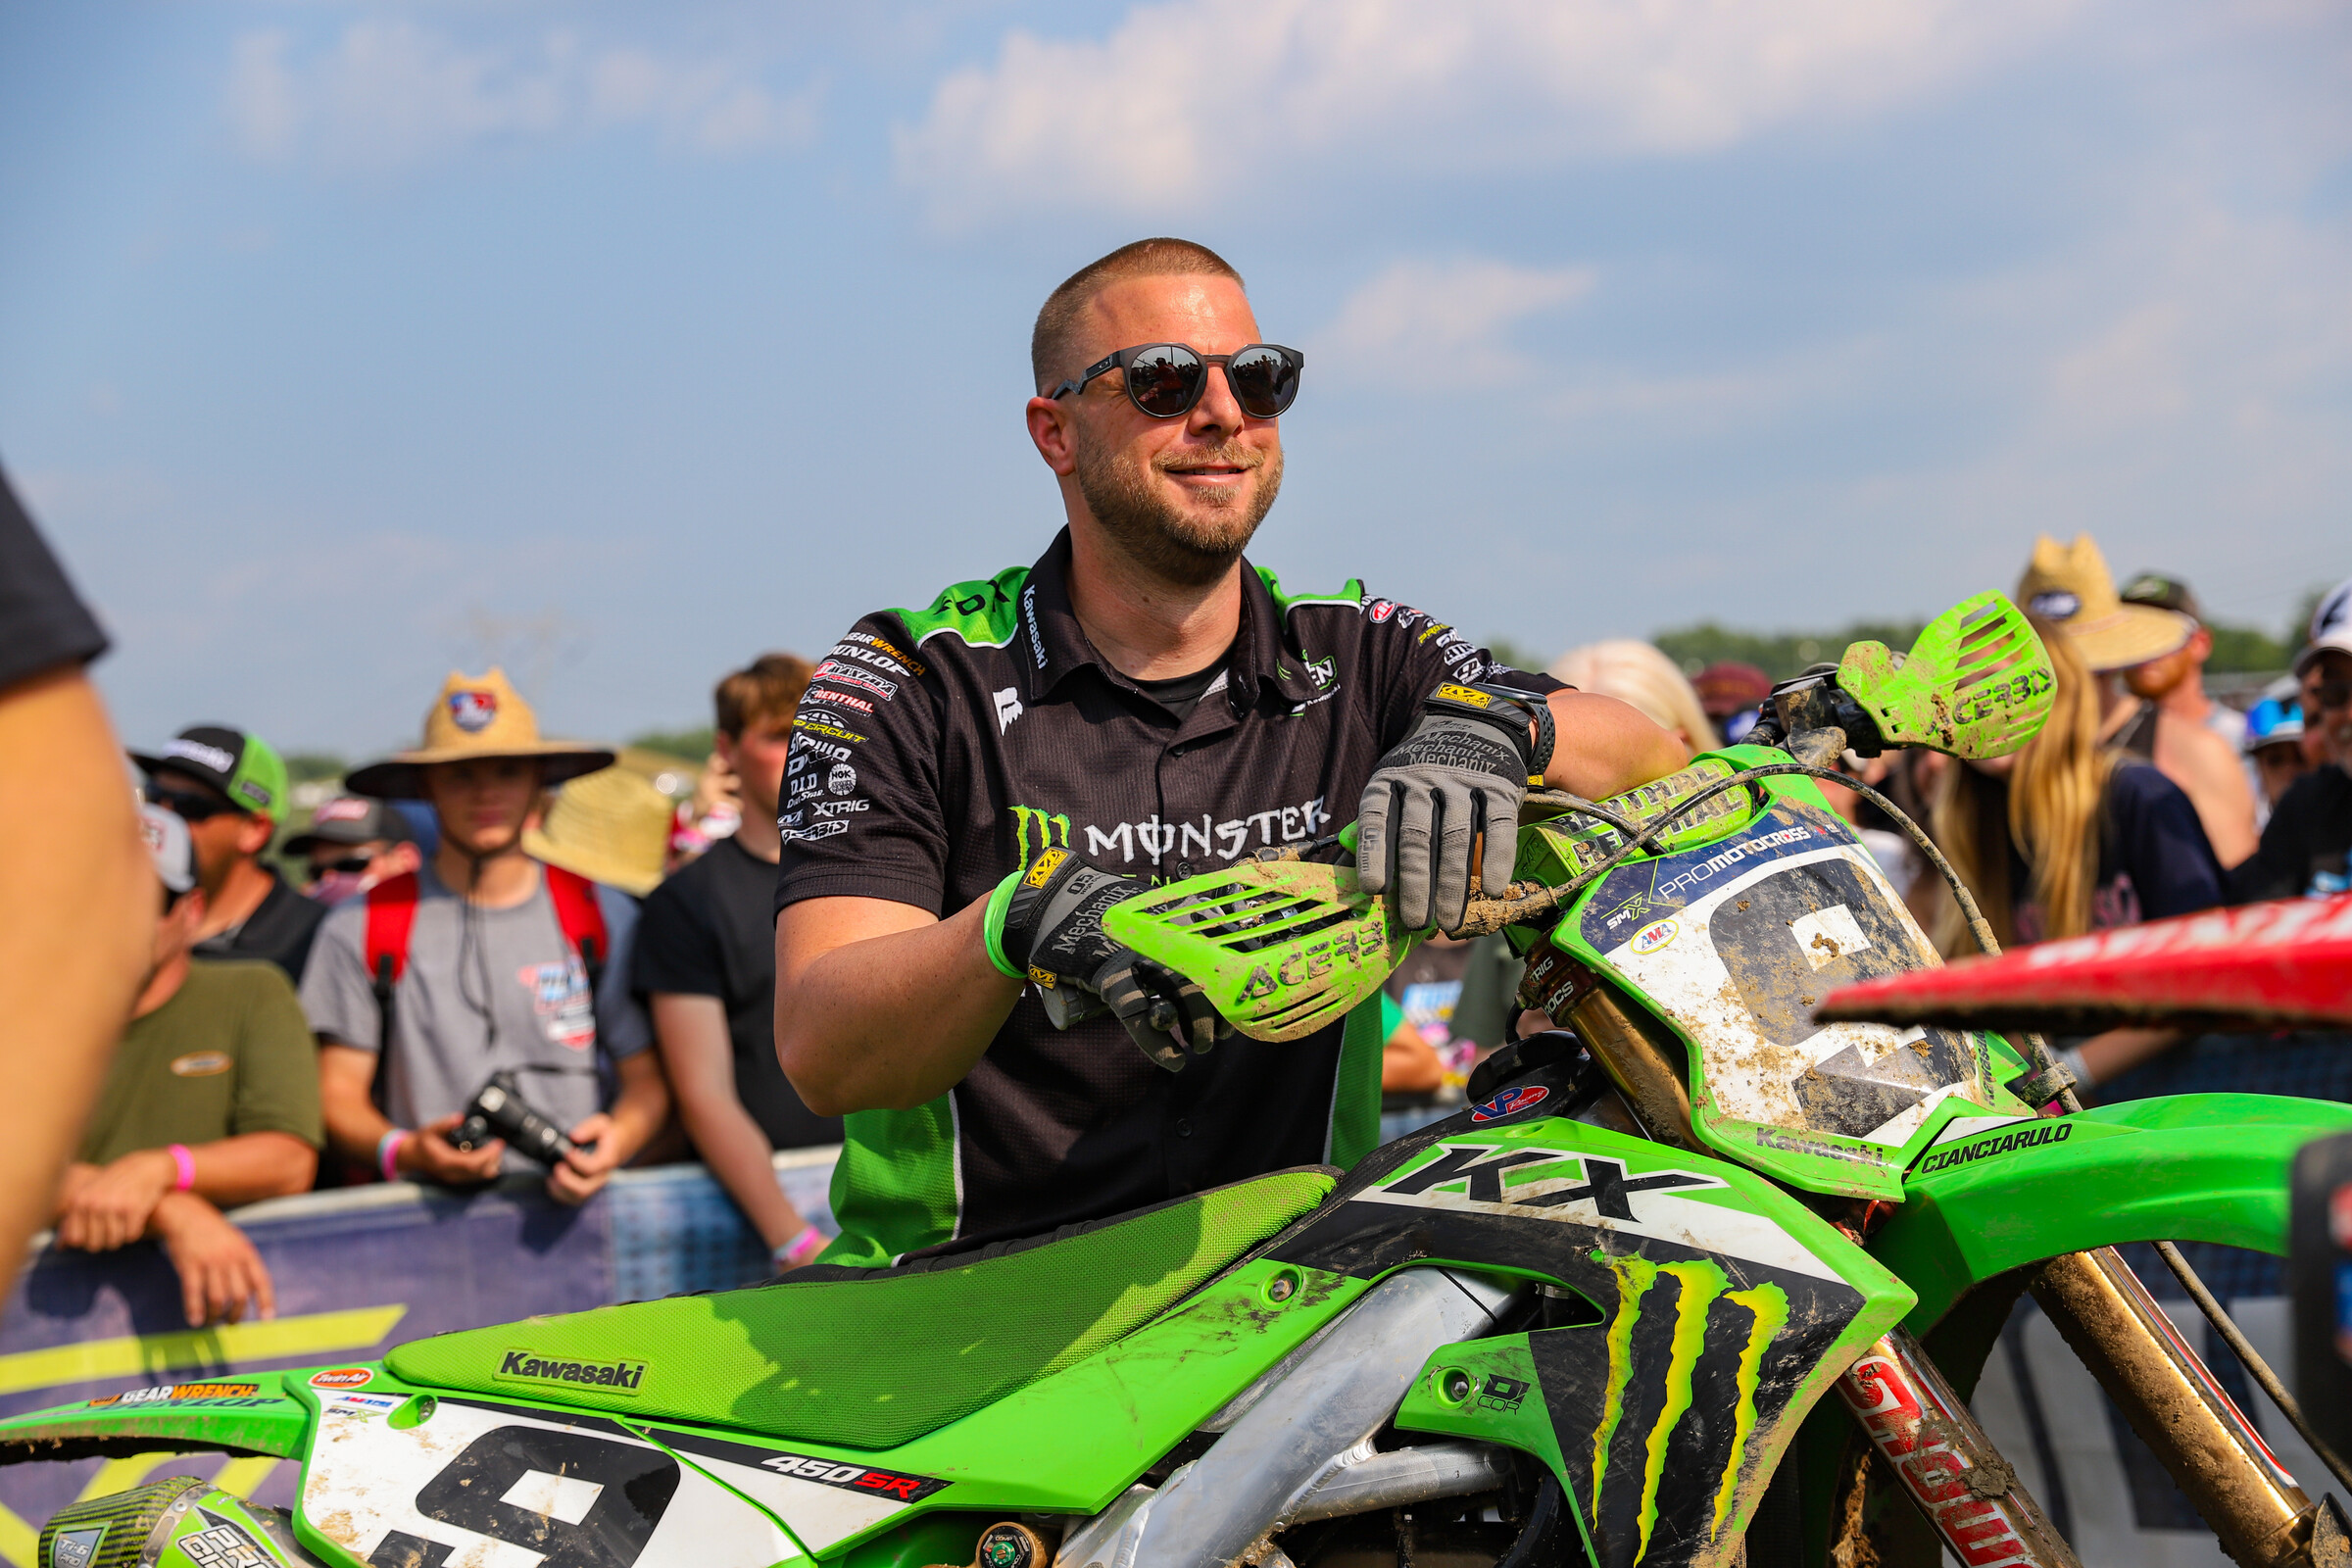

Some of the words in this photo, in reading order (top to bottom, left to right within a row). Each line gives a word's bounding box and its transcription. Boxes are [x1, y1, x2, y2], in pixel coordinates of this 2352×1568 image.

[1024, 584, 1049, 670] Kawasaki
[814, 689, 874, 713] RENTHAL
[805, 723, 867, 743] CIRCUIT
[831, 769, 852, 779] NGK
[811, 800, 869, 817] XTRIG
[1052, 885, 1134, 955] Mechanix
[1641, 923, 1672, 949] AMA
[1472, 1088, 1524, 1118] VP
[1756, 1127, 1884, 1167] Kawasaki
[1922, 1123, 2073, 1173] CIANCIARULO
[1382, 1149, 1718, 1223] KX
[501, 1351, 644, 1389] Kawasaki
[121, 1384, 257, 1404] GEARWRENCH
